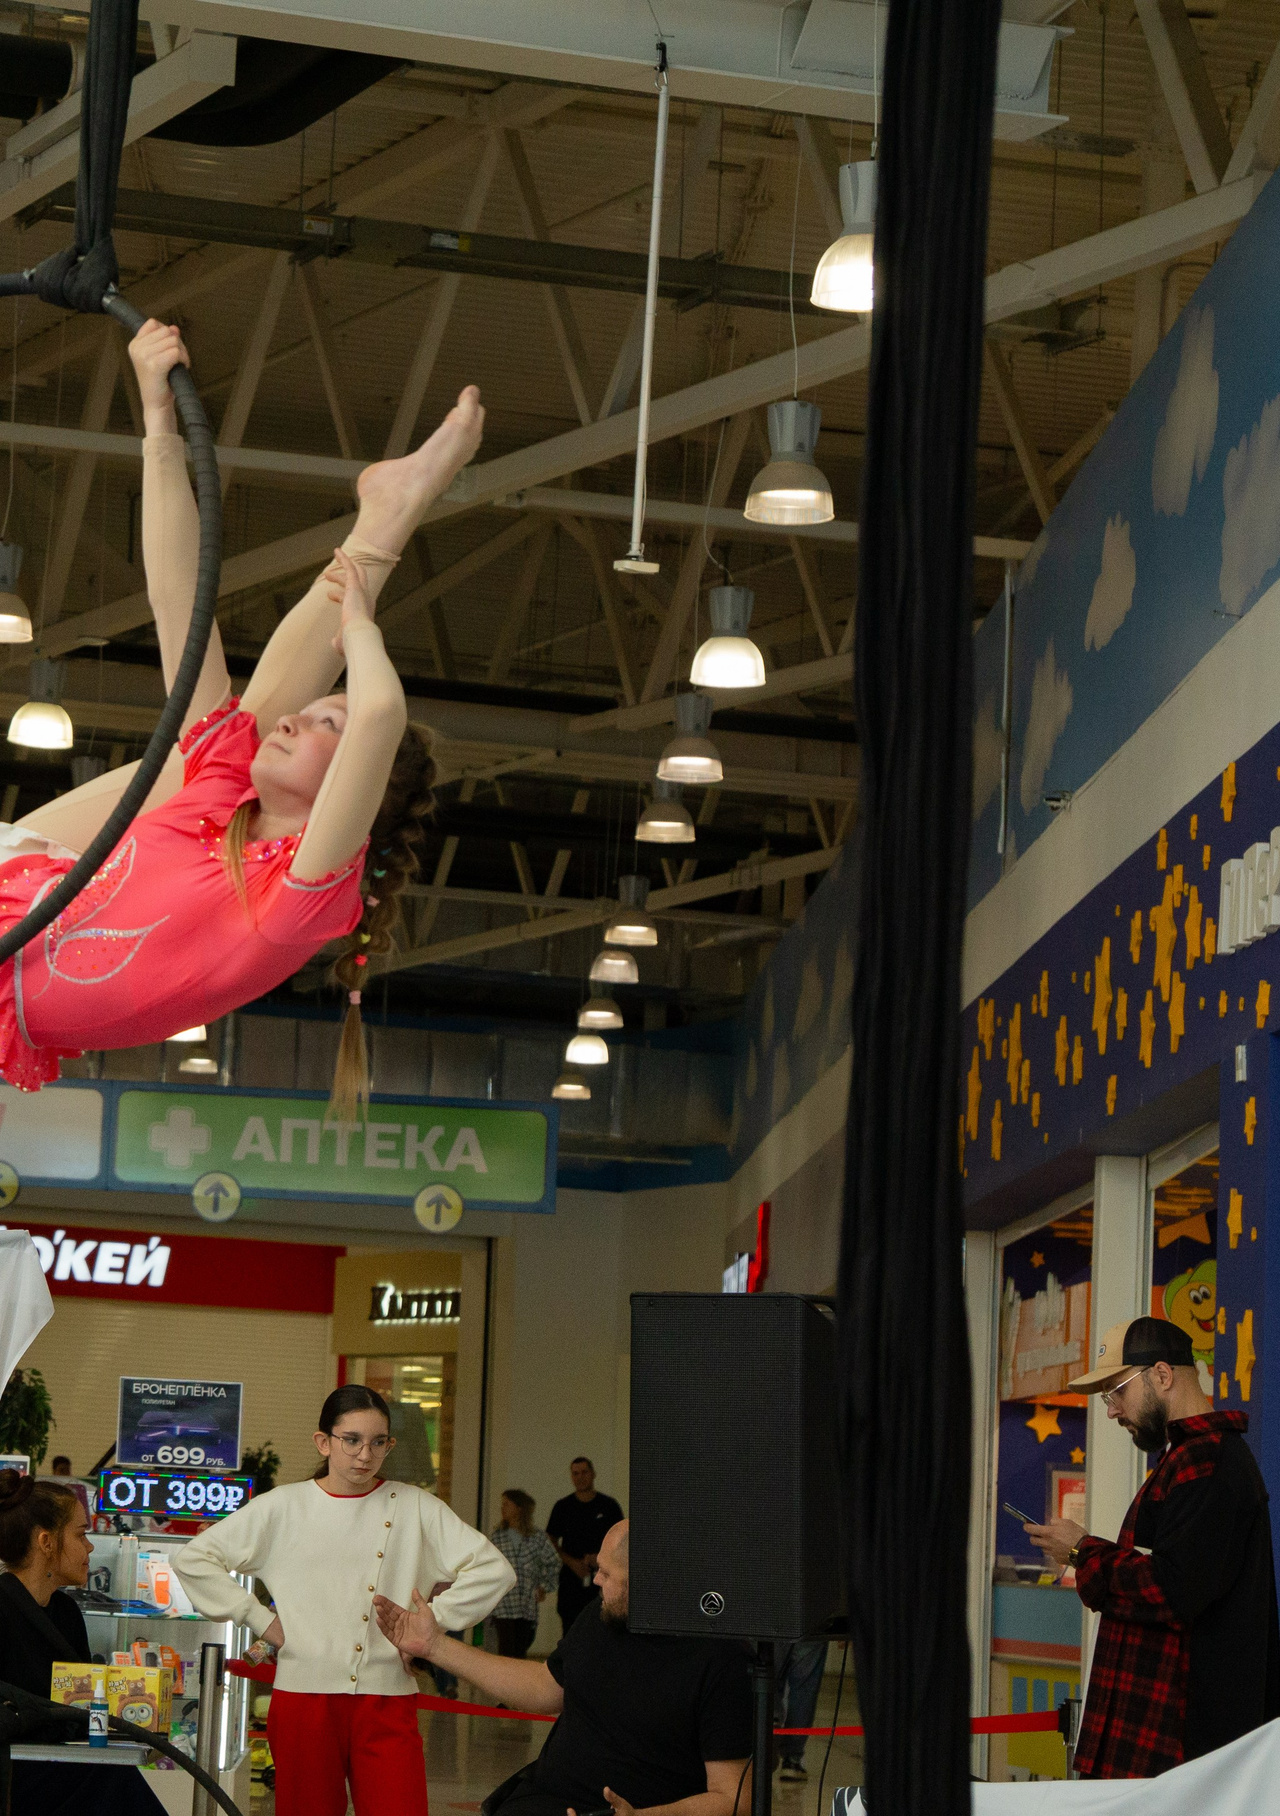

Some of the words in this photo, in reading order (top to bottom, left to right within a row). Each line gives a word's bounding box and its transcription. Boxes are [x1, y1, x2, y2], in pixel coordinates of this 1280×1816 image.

[232, 1116, 488, 1173] АПТЕКА
[132, 1382, 227, 1398] БРОНЕПЛЁНКА
[141, 1454, 155, 1463] ОТ
[157, 1446, 205, 1465] 699
[206, 1457, 227, 1467] РУБ.
[108, 1476, 159, 1507] ОТ
